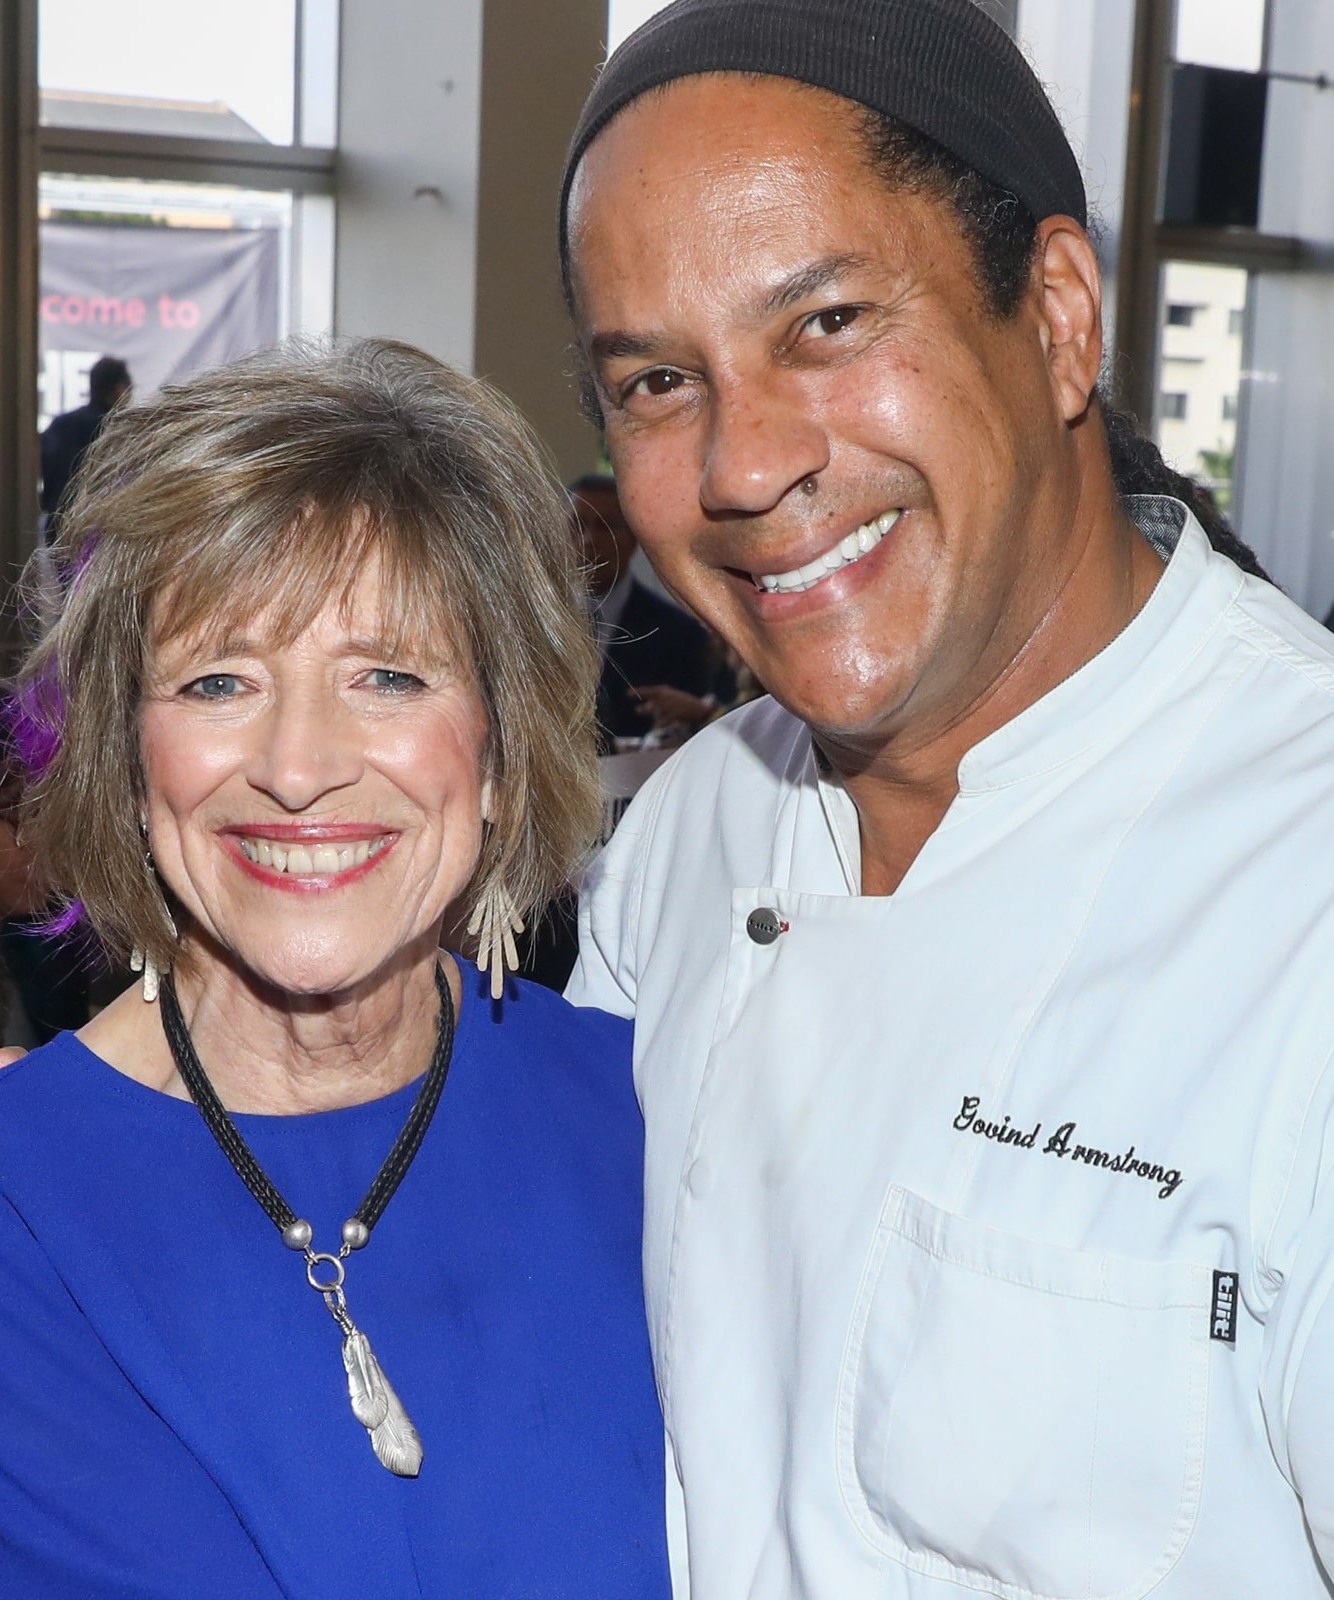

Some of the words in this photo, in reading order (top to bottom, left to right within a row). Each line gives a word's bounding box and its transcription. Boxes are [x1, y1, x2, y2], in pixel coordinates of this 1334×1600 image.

[157, 293, 200, 329] to
[953, 1096, 1042, 1149] Govind
[1043, 1122, 1183, 1199] Armstrong
[1213, 1275, 1234, 1338] tilit
